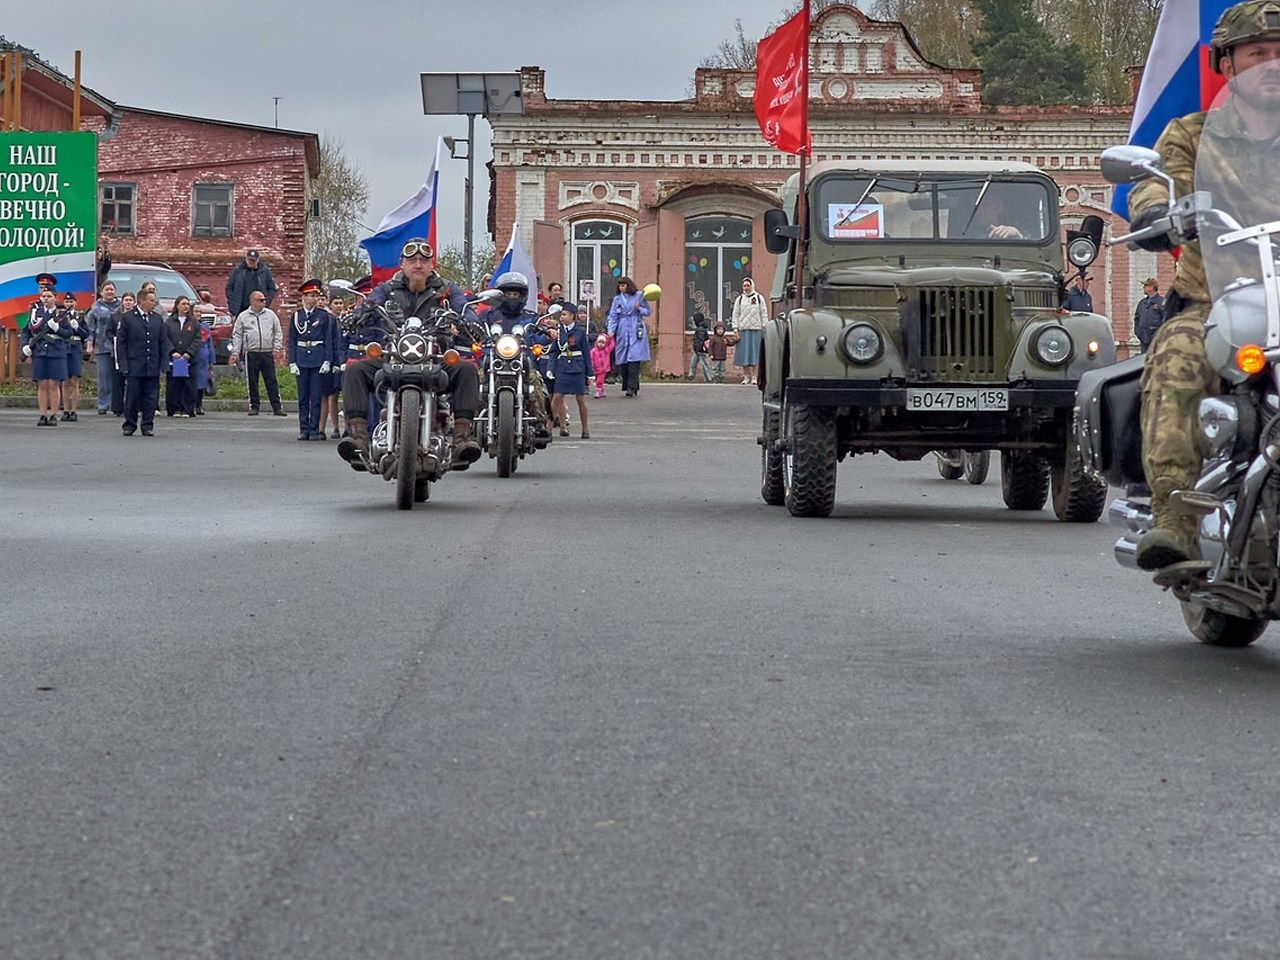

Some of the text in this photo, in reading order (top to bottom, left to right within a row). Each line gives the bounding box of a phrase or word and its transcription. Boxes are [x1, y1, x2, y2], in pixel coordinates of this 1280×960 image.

[9, 145, 57, 166] НАШ
[0, 172, 59, 198] ГОРОД
[0, 200, 66, 221] ВЕЧНО
[0, 222, 85, 252] ОЛОДОЙ!
[912, 391, 1004, 409] В047ВМ 159
